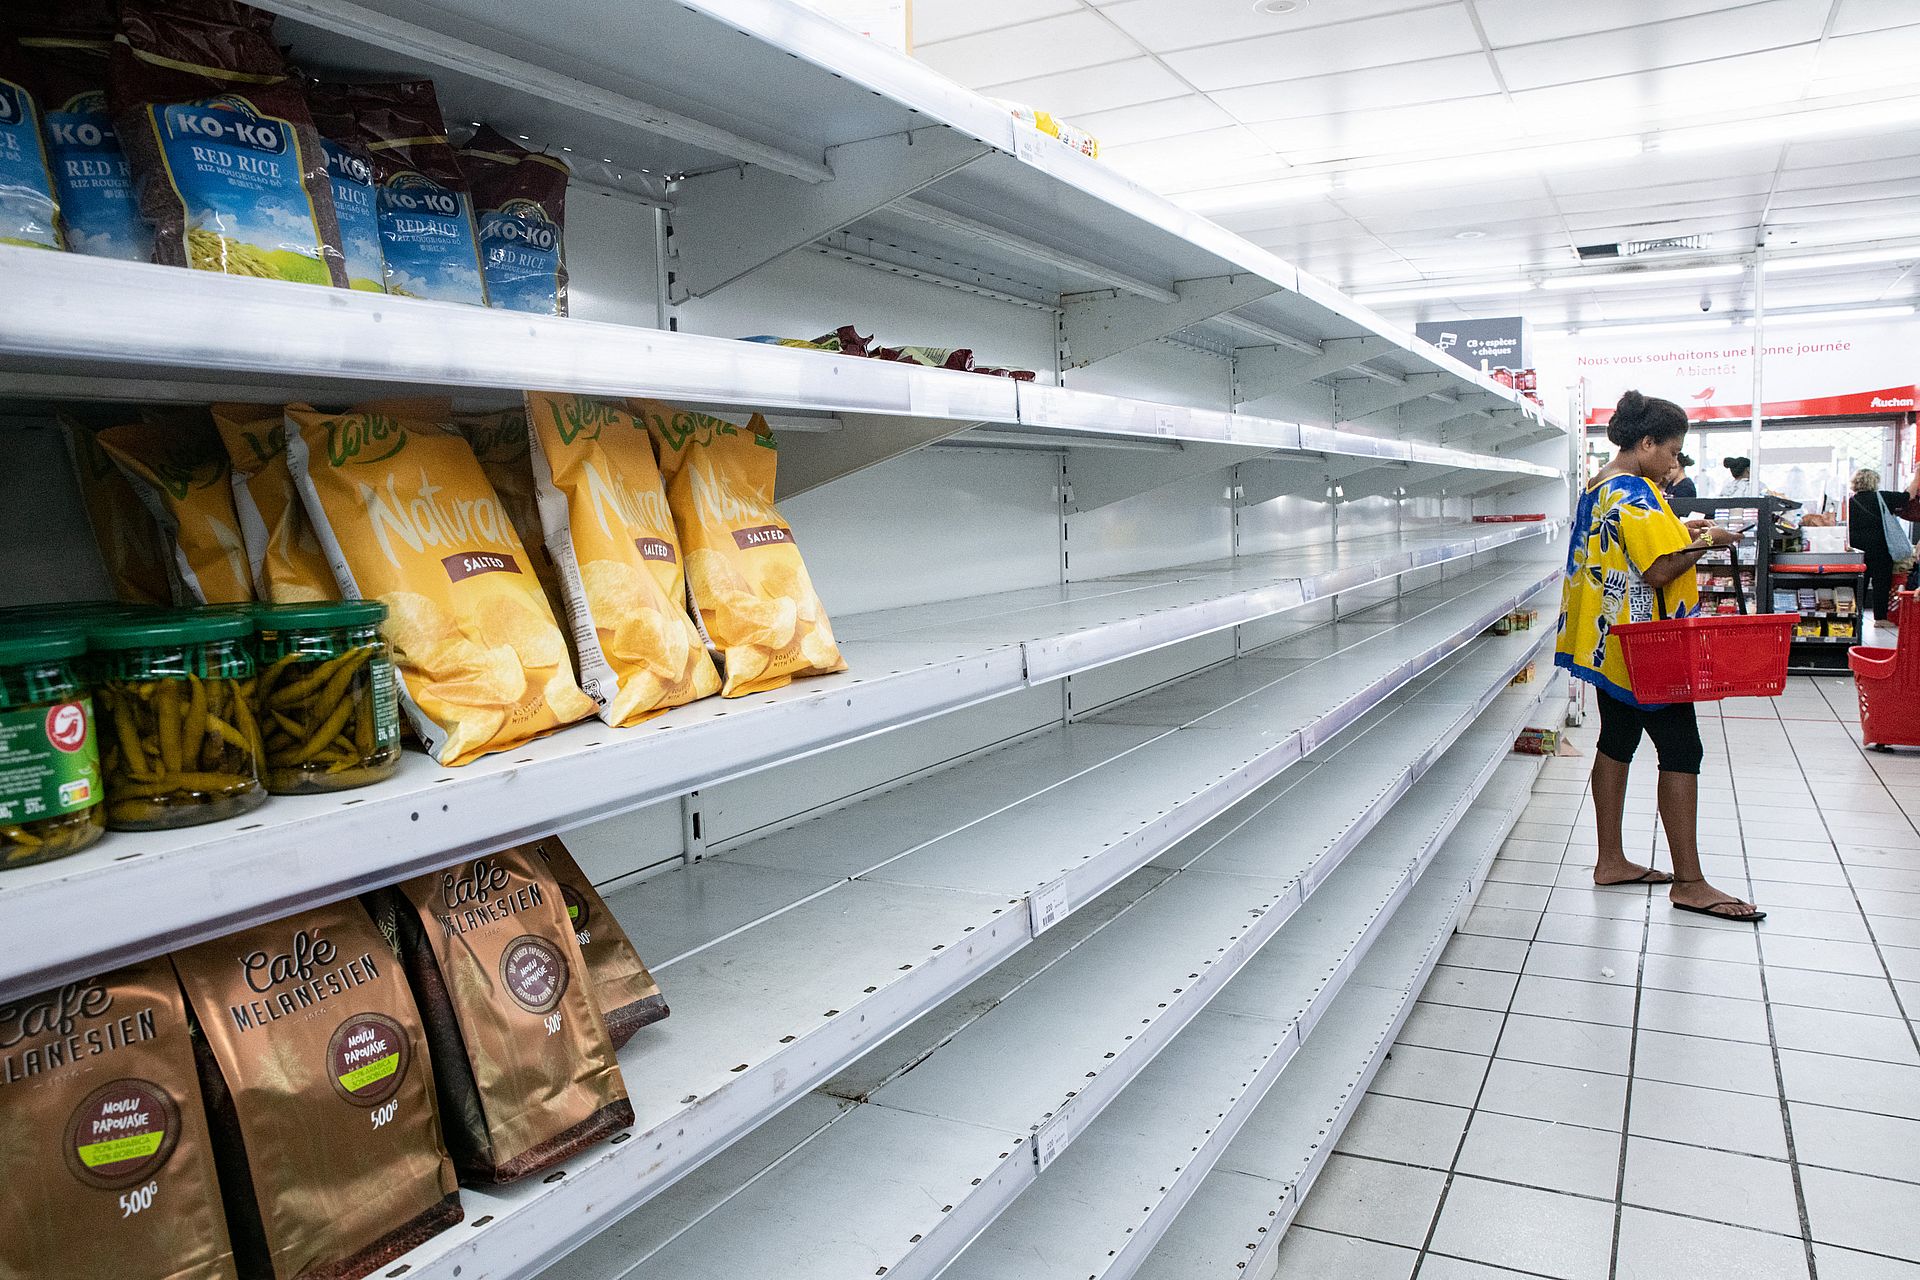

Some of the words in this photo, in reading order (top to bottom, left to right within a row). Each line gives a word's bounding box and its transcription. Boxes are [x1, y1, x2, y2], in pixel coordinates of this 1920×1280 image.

[51, 123, 115, 146] KO-
[177, 113, 278, 149] KO-KO
[65, 160, 111, 177] RED
[191, 146, 232, 168] RED
[236, 154, 281, 179] RICE
[339, 188, 369, 207] RICE
[383, 192, 455, 213] KO-KO
[395, 219, 423, 233] RED
[427, 219, 460, 237] RICE
[488, 221, 553, 248] KO-KO
[519, 253, 547, 271] RICE
[1466, 339, 1478, 348] CB
[1485, 338, 1517, 348] espèces
[1478, 347, 1512, 357] chèques
[1578, 356, 1609, 366] Nous
[1612, 356, 1642, 364] vous
[1646, 350, 1719, 363] souhaitons
[1722, 348, 1747, 358] une
[1797, 340, 1851, 356] journée
[1871, 397, 1914, 408] Auchan
[746, 529, 785, 543] SALTED
[643, 543, 668, 558] SALTED
[464, 556, 505, 572] SALTED
[440, 858, 511, 911] Café
[437, 882, 544, 939] MELANESIEN
[238, 928, 337, 994] Café
[520, 958, 538, 978] MOULU
[230, 953, 380, 1034] MELANESIEN
[0, 1007, 157, 1086] LANESIEN
[348, 1028, 376, 1049] MOULU
[344, 1039, 388, 1065] PAPOUASIE
[101, 1097, 141, 1116] MOULU
[371, 1099, 399, 1130] 500G
[92, 1112, 150, 1135] PAPOUASIE
[119, 1181, 158, 1219] 500G
